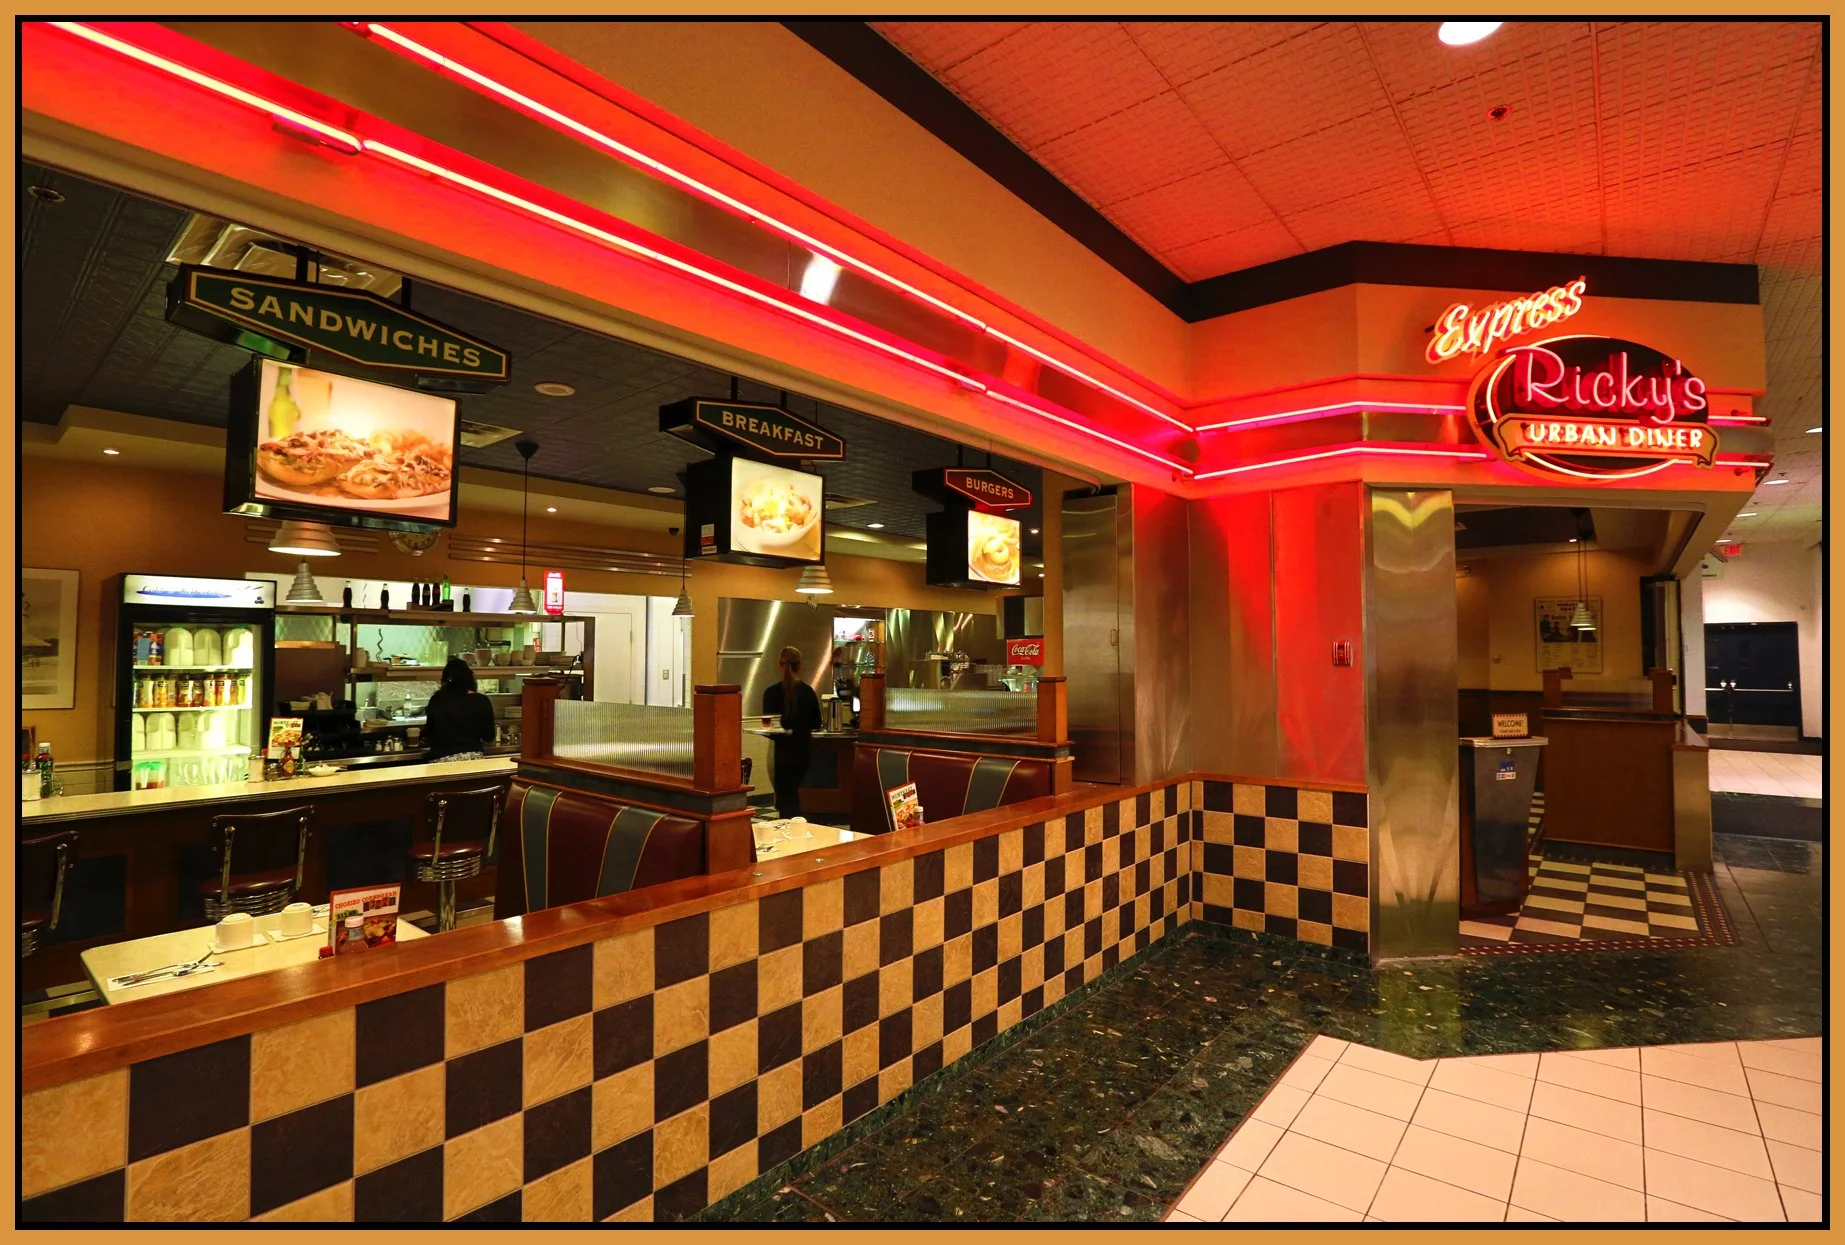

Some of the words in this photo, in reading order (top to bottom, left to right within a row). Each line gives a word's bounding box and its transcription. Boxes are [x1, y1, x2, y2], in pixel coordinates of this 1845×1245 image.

[229, 287, 481, 367] SANDWICHES
[1430, 279, 1586, 361] Express
[1505, 345, 1707, 425] Ricky's
[722, 410, 823, 450] BREAKFAST
[1529, 422, 1617, 446] URBAN
[1628, 426, 1703, 448] DINER
[965, 476, 1014, 499] BURGERS
[1724, 543, 1742, 557] EXIT
[334, 898, 361, 910] CHORIZO
